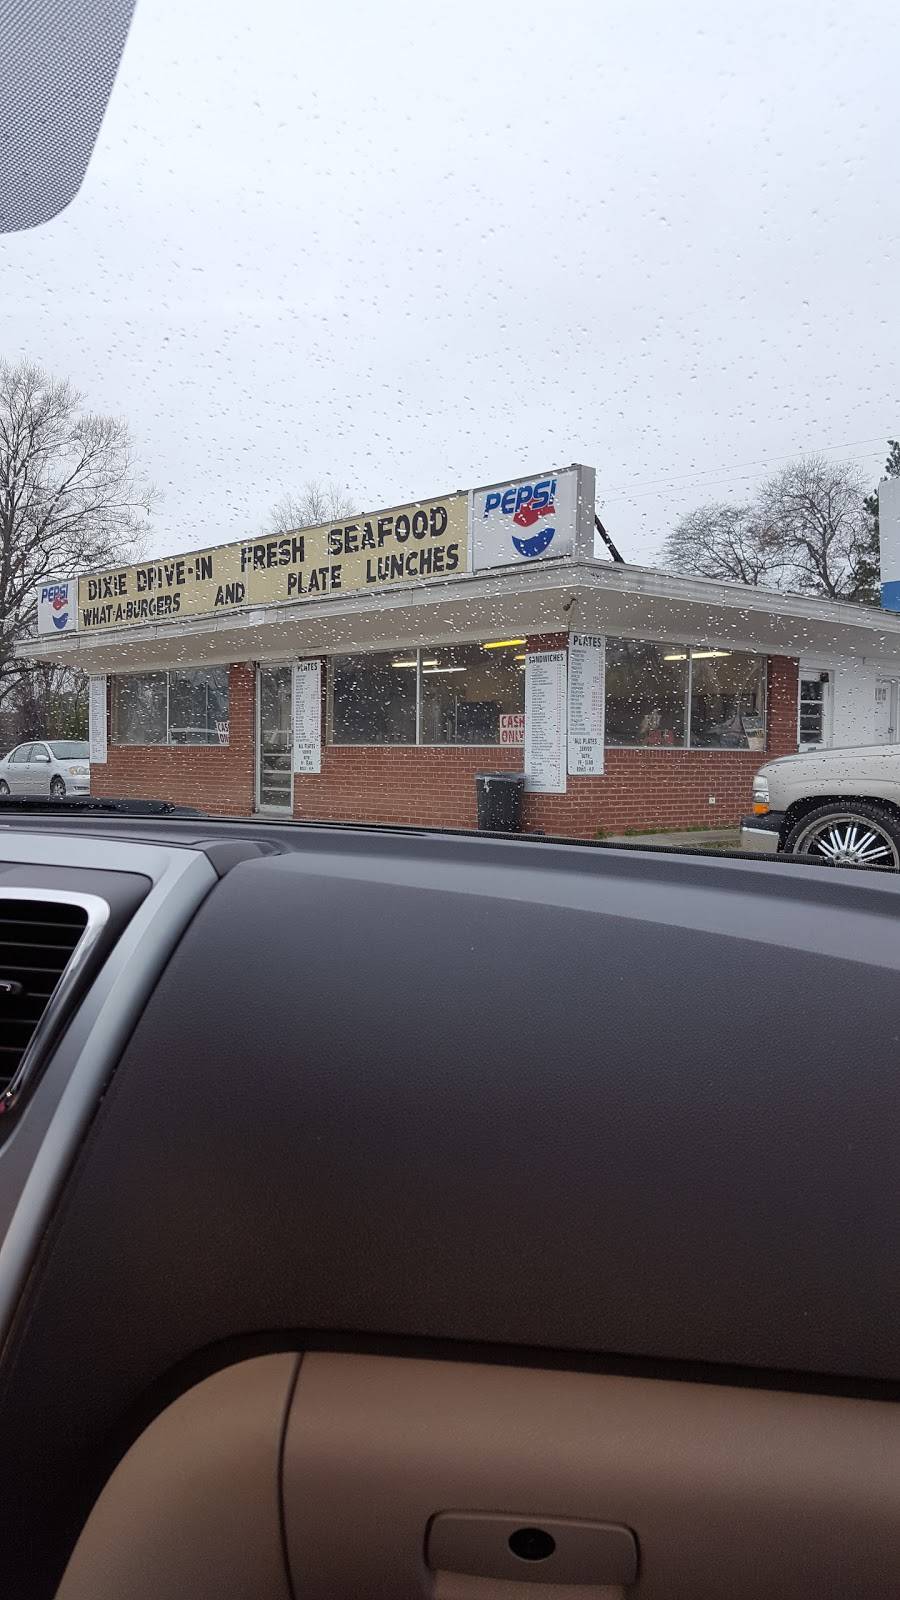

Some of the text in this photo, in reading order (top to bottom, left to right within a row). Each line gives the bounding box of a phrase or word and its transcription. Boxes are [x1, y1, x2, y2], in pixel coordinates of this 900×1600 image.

[483, 479, 557, 518] PEPSI
[241, 506, 448, 572] FRESH SEAFOOD
[214, 582, 246, 606] AND
[287, 564, 342, 596] PLATE
[366, 543, 459, 583] LUNCHES
[41, 583, 69, 603] PEPSI
[88, 574, 128, 601] DIXIE
[573, 635, 602, 647] PLATES
[528, 653, 564, 664] SANDWICHES
[297, 662, 318, 672] PLATES
[502, 715, 525, 728] CASH
[502, 730, 524, 743] ONLY
